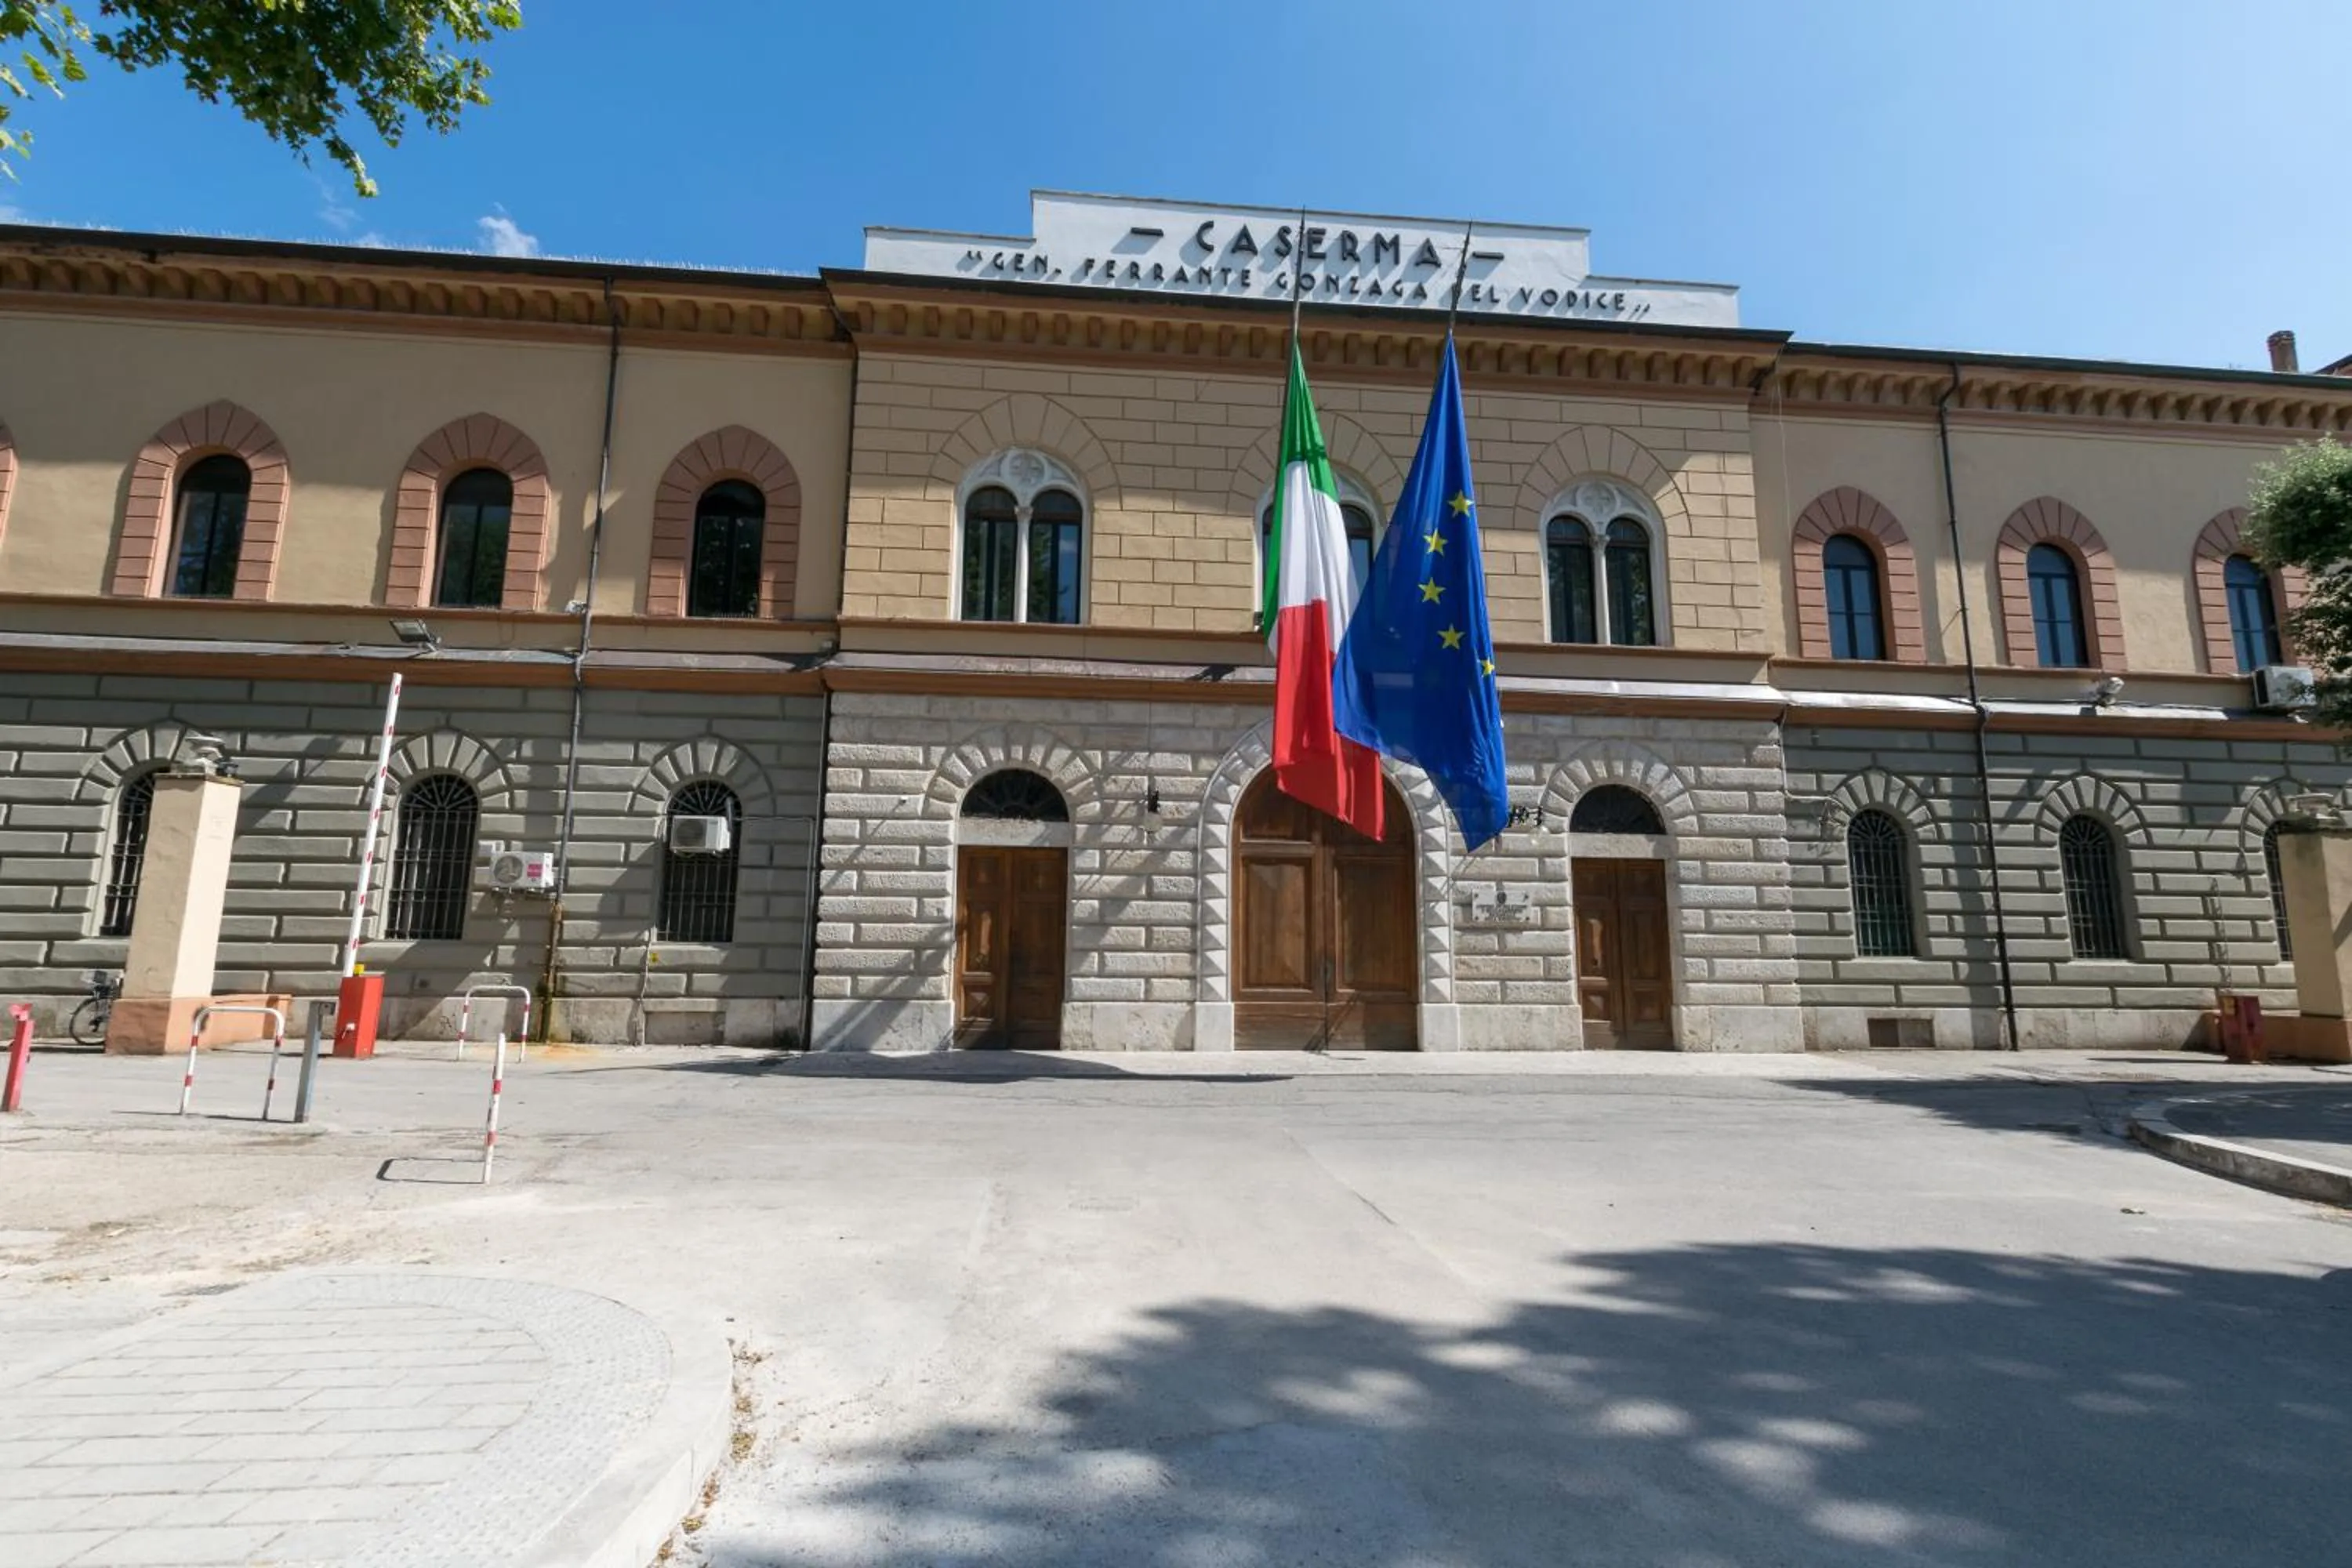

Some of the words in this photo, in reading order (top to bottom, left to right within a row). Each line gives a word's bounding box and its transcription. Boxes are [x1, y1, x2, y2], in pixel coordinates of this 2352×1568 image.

[1196, 220, 1441, 267] CASERMA
[1084, 258, 1250, 287] FERRANTE
[1276, 272, 1428, 299] GONZAGA
